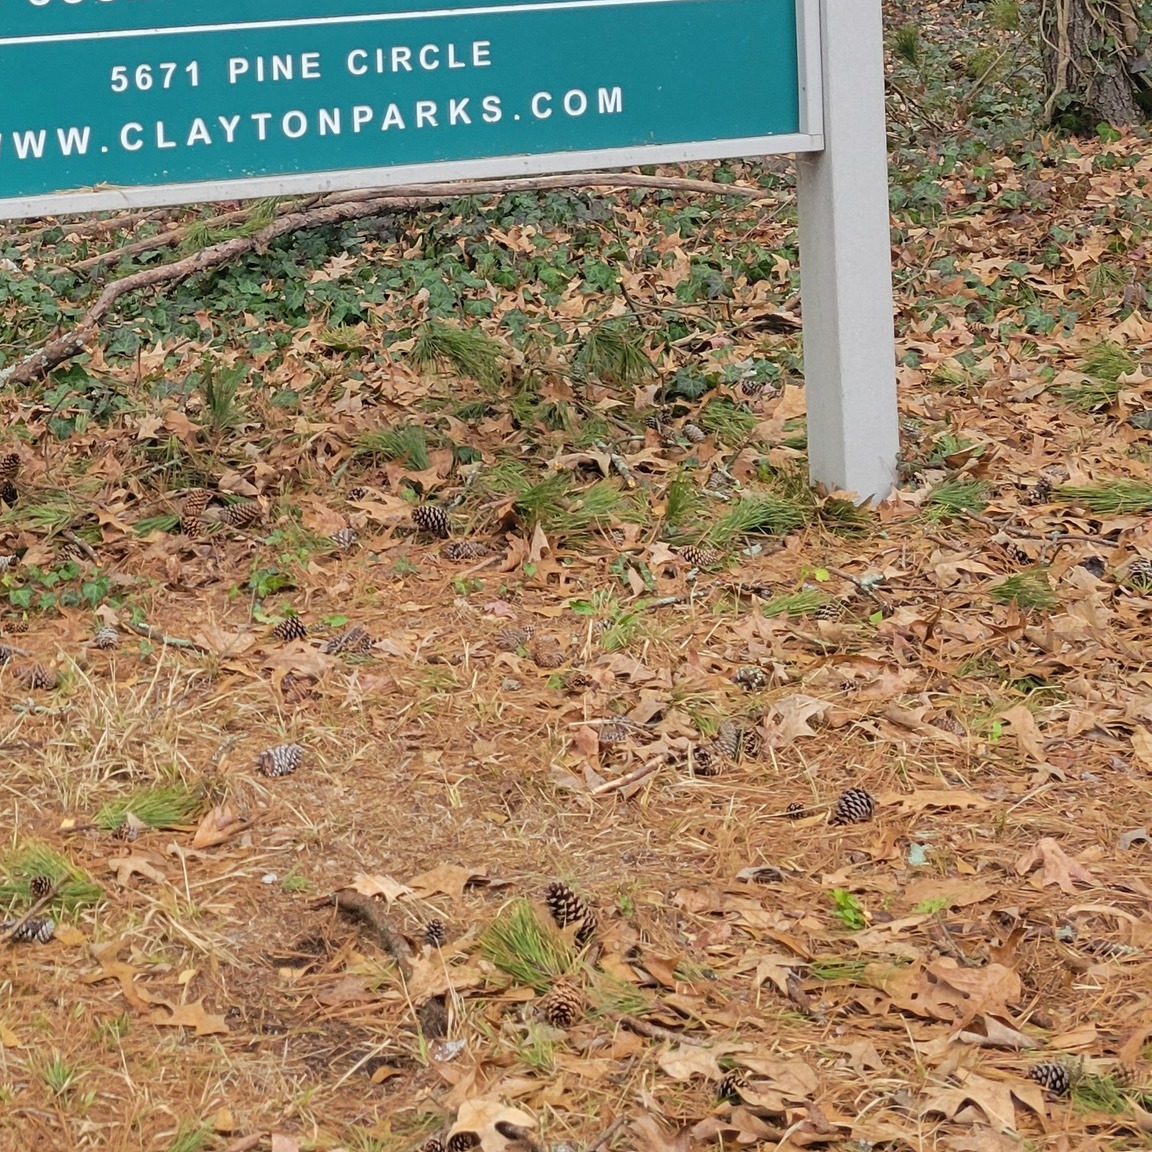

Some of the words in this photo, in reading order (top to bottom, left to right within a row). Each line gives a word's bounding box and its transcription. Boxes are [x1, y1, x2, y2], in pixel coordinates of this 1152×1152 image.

[112, 61, 197, 91] 5671
[230, 53, 320, 83] PINE
[348, 41, 490, 74] CIRCLE
